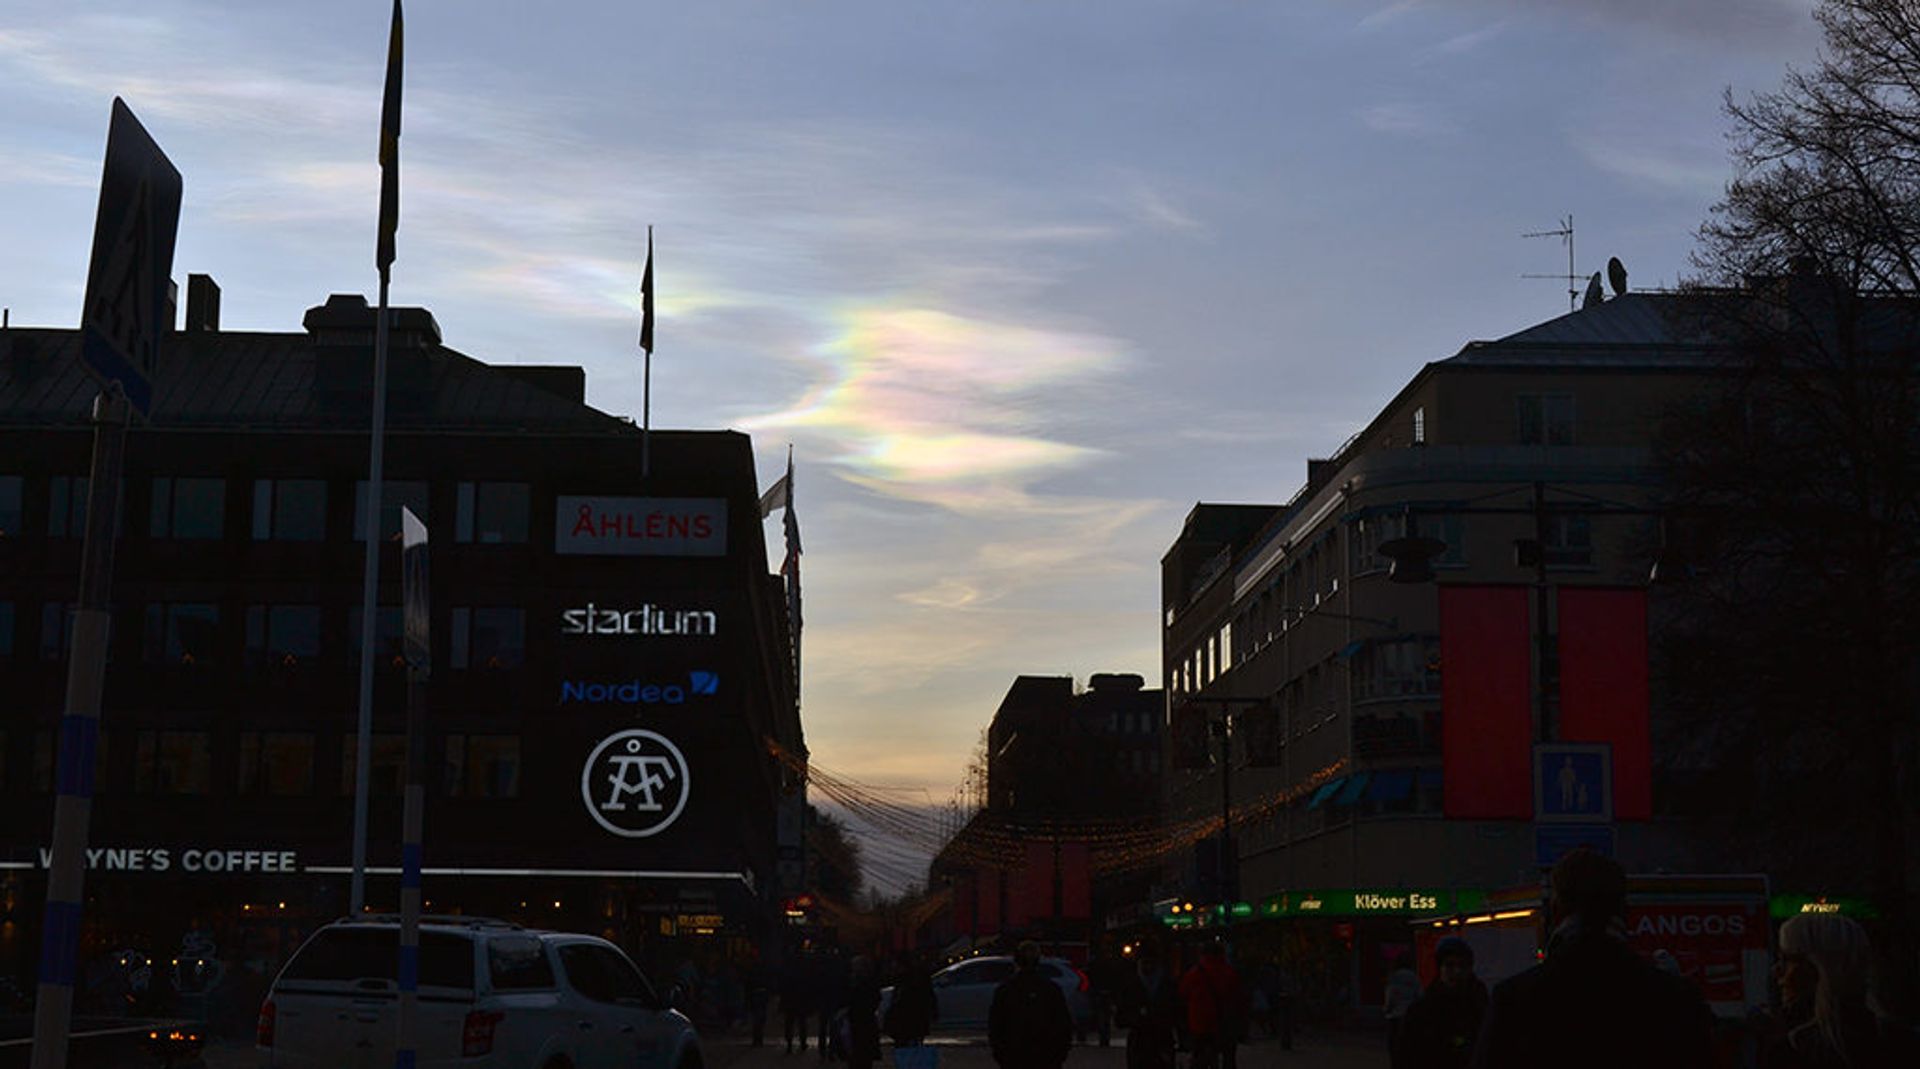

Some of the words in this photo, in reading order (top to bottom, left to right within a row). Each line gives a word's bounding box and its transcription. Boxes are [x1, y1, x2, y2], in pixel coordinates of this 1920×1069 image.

[571, 505, 713, 538] ÅHLÉNS
[561, 602, 717, 636] stadium
[561, 680, 686, 704] Nordea
[39, 848, 171, 872] WYNE'S
[181, 849, 297, 873] COFFEE
[1355, 893, 1406, 909] Klöver
[1410, 893, 1437, 909] Ess
[1626, 914, 1746, 936] ANGOS
